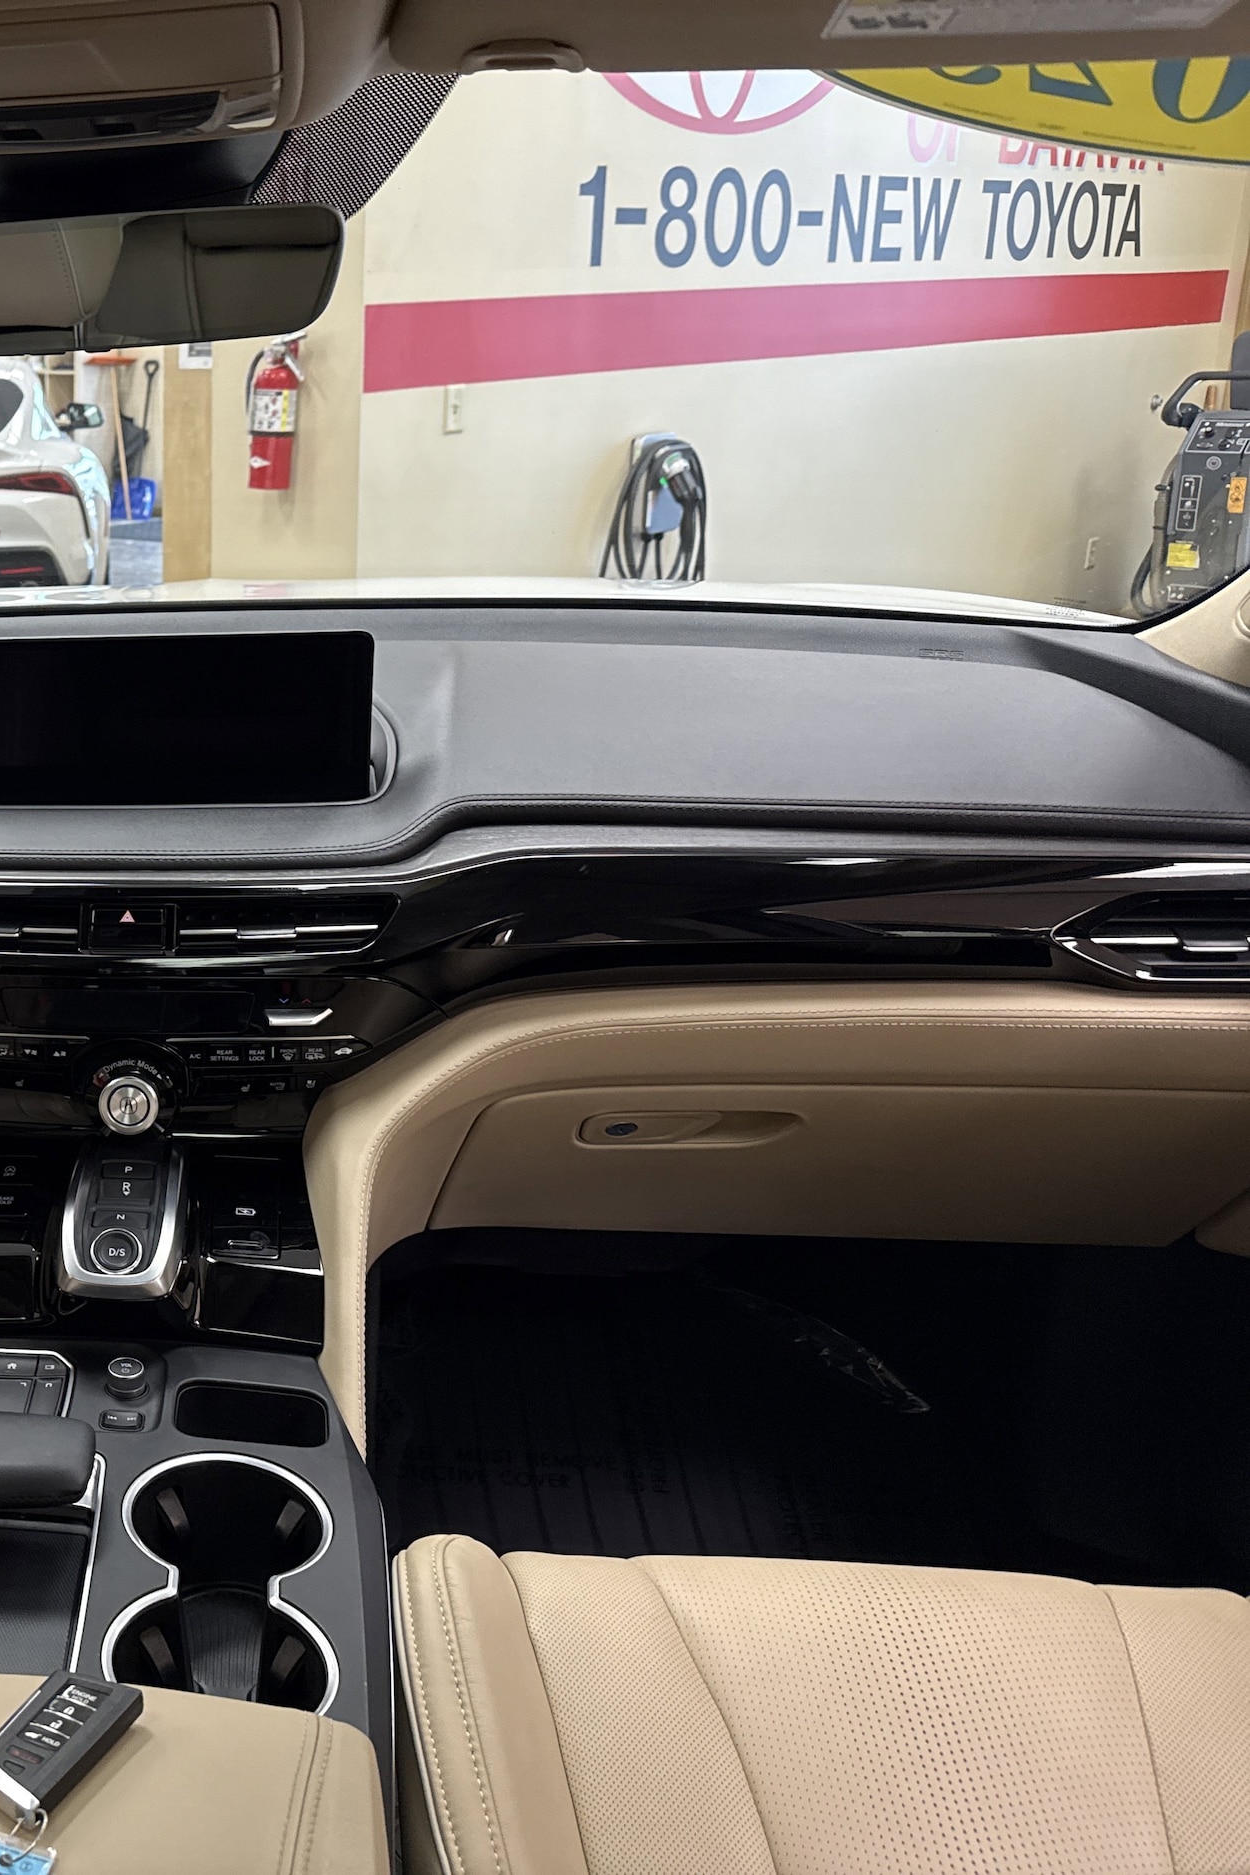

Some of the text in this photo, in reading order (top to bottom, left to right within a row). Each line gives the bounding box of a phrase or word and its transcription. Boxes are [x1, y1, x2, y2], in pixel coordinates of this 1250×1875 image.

[578, 165, 1143, 268] 1-800-NEW TOYOTA
[103, 1058, 158, 1075] Dynamic Mode
[124, 1166, 133, 1174] P
[122, 1181, 131, 1192] R
[108, 1247, 126, 1257] D/S
[71, 1688, 98, 1701] ENGINE
[41, 1736, 62, 1748] HOLD
